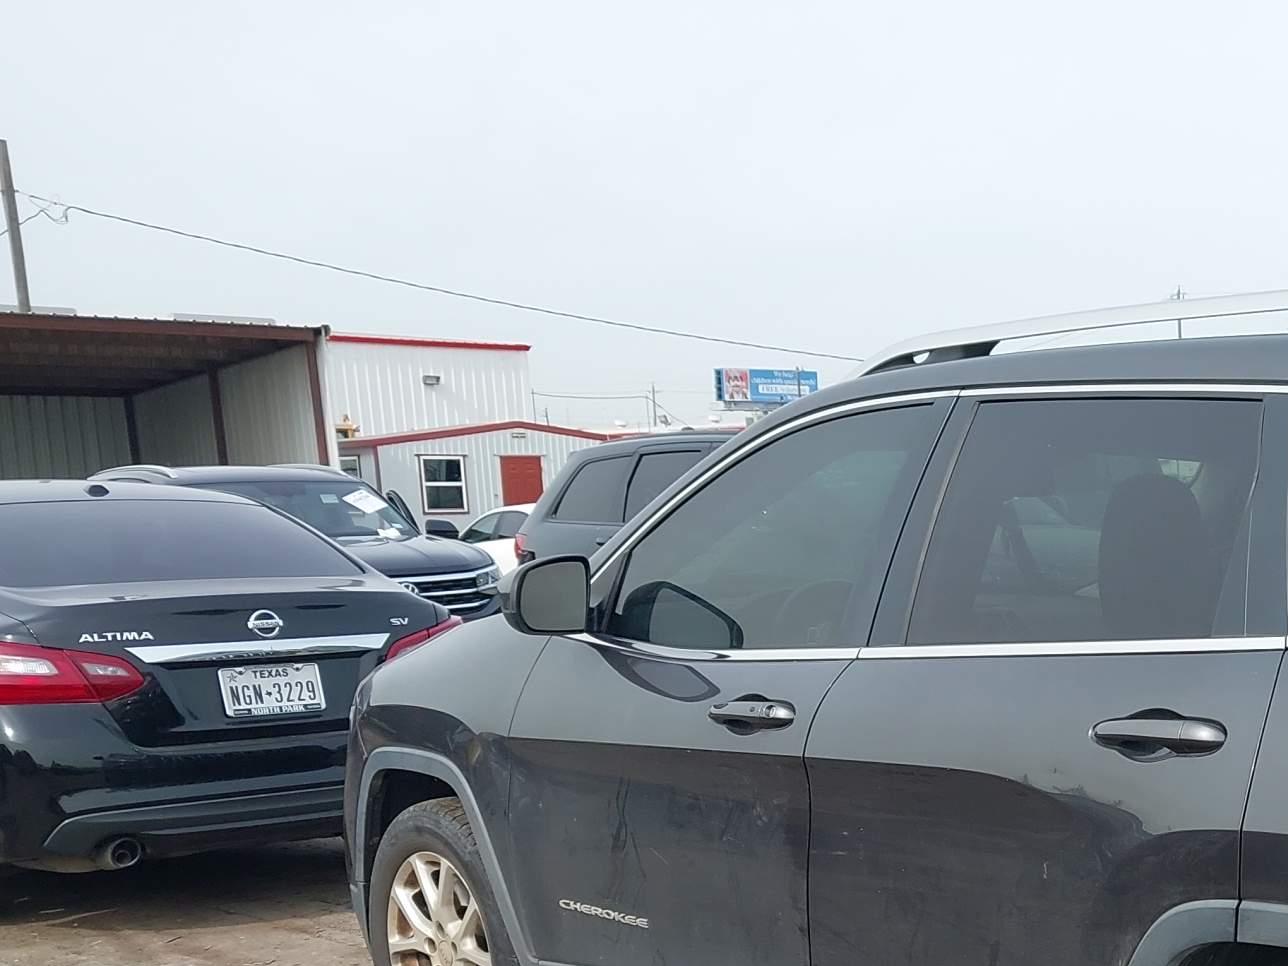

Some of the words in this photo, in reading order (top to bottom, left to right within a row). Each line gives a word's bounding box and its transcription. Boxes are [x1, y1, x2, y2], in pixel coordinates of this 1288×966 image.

[390, 617, 409, 626] SV
[78, 631, 155, 643] ALTIMA
[251, 668, 289, 679] TEXAS
[229, 683, 265, 707] NGN
[272, 680, 317, 703] 3229
[251, 706, 281, 716] NORTH
[282, 704, 306, 713] PARK
[559, 899, 649, 929] CHEROKEE
